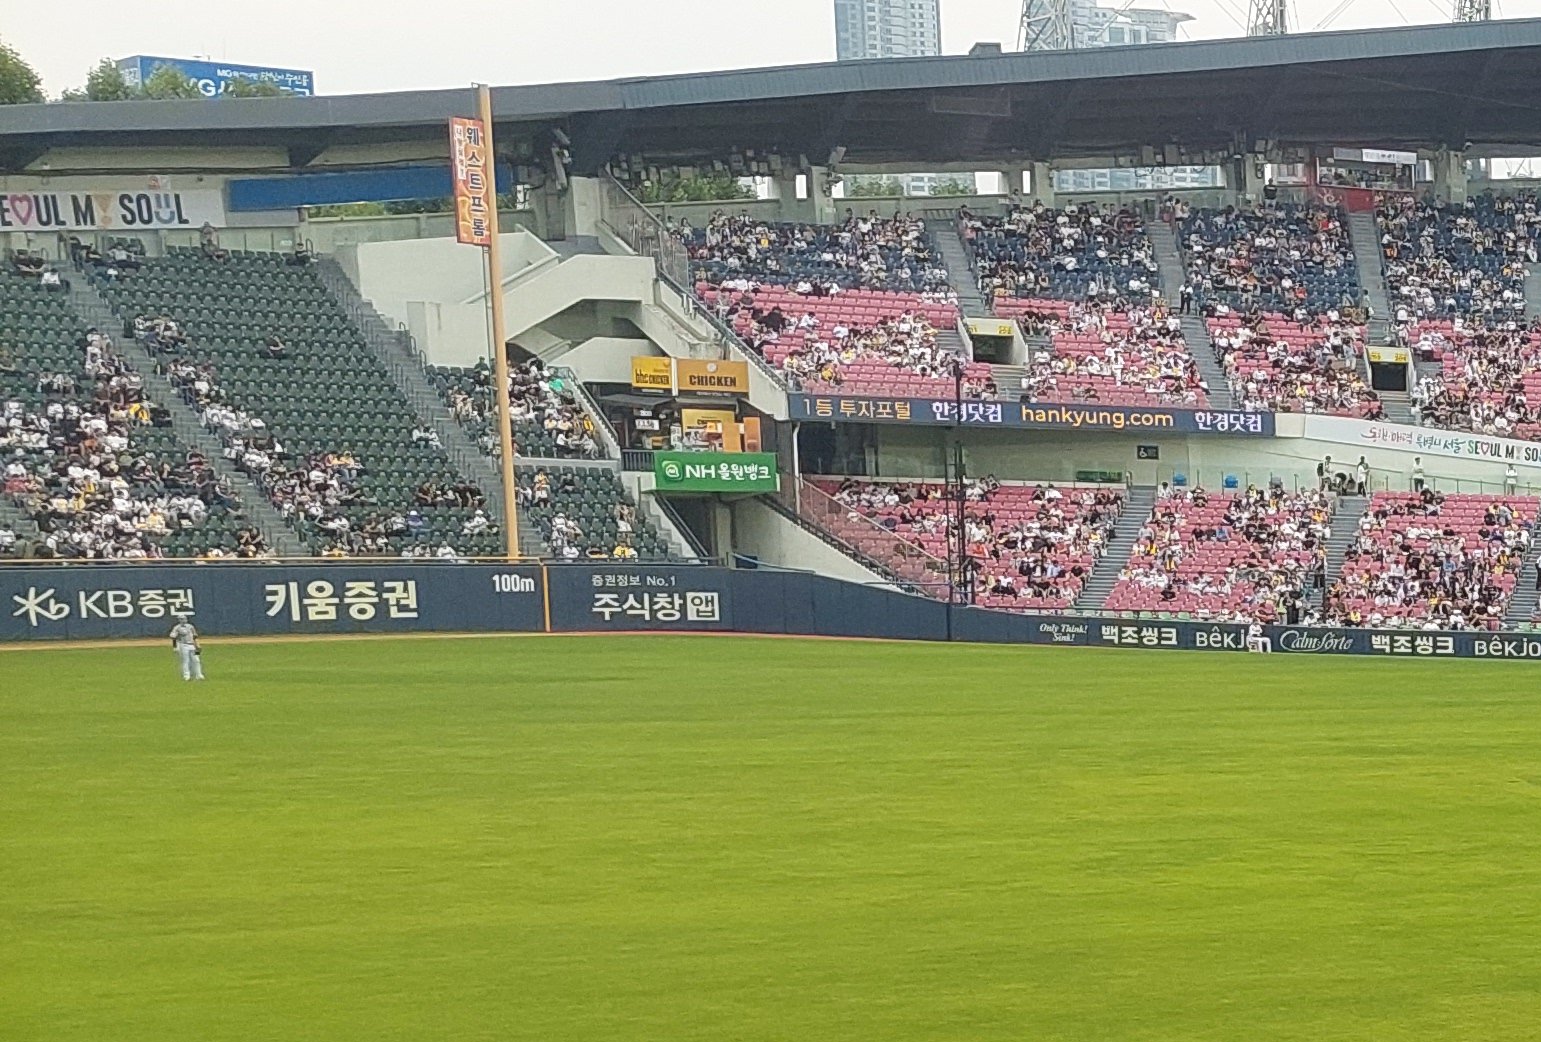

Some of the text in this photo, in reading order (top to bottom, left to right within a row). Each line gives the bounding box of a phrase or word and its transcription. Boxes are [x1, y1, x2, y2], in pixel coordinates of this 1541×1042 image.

[689, 374, 737, 387] CHICKEN
[804, 400, 834, 417] 1등
[839, 400, 911, 420] 투자포털
[1021, 405, 1174, 428] hankyung.com
[1194, 410, 1263, 433] 한경닷컴
[492, 574, 535, 592] 100m
[592, 575, 676, 587] 증권정보 No.1
[265, 580, 418, 621] 키움증권
[1101, 624, 1178, 646] 백조씽크
[1371, 634, 1454, 655] 백조씽크
